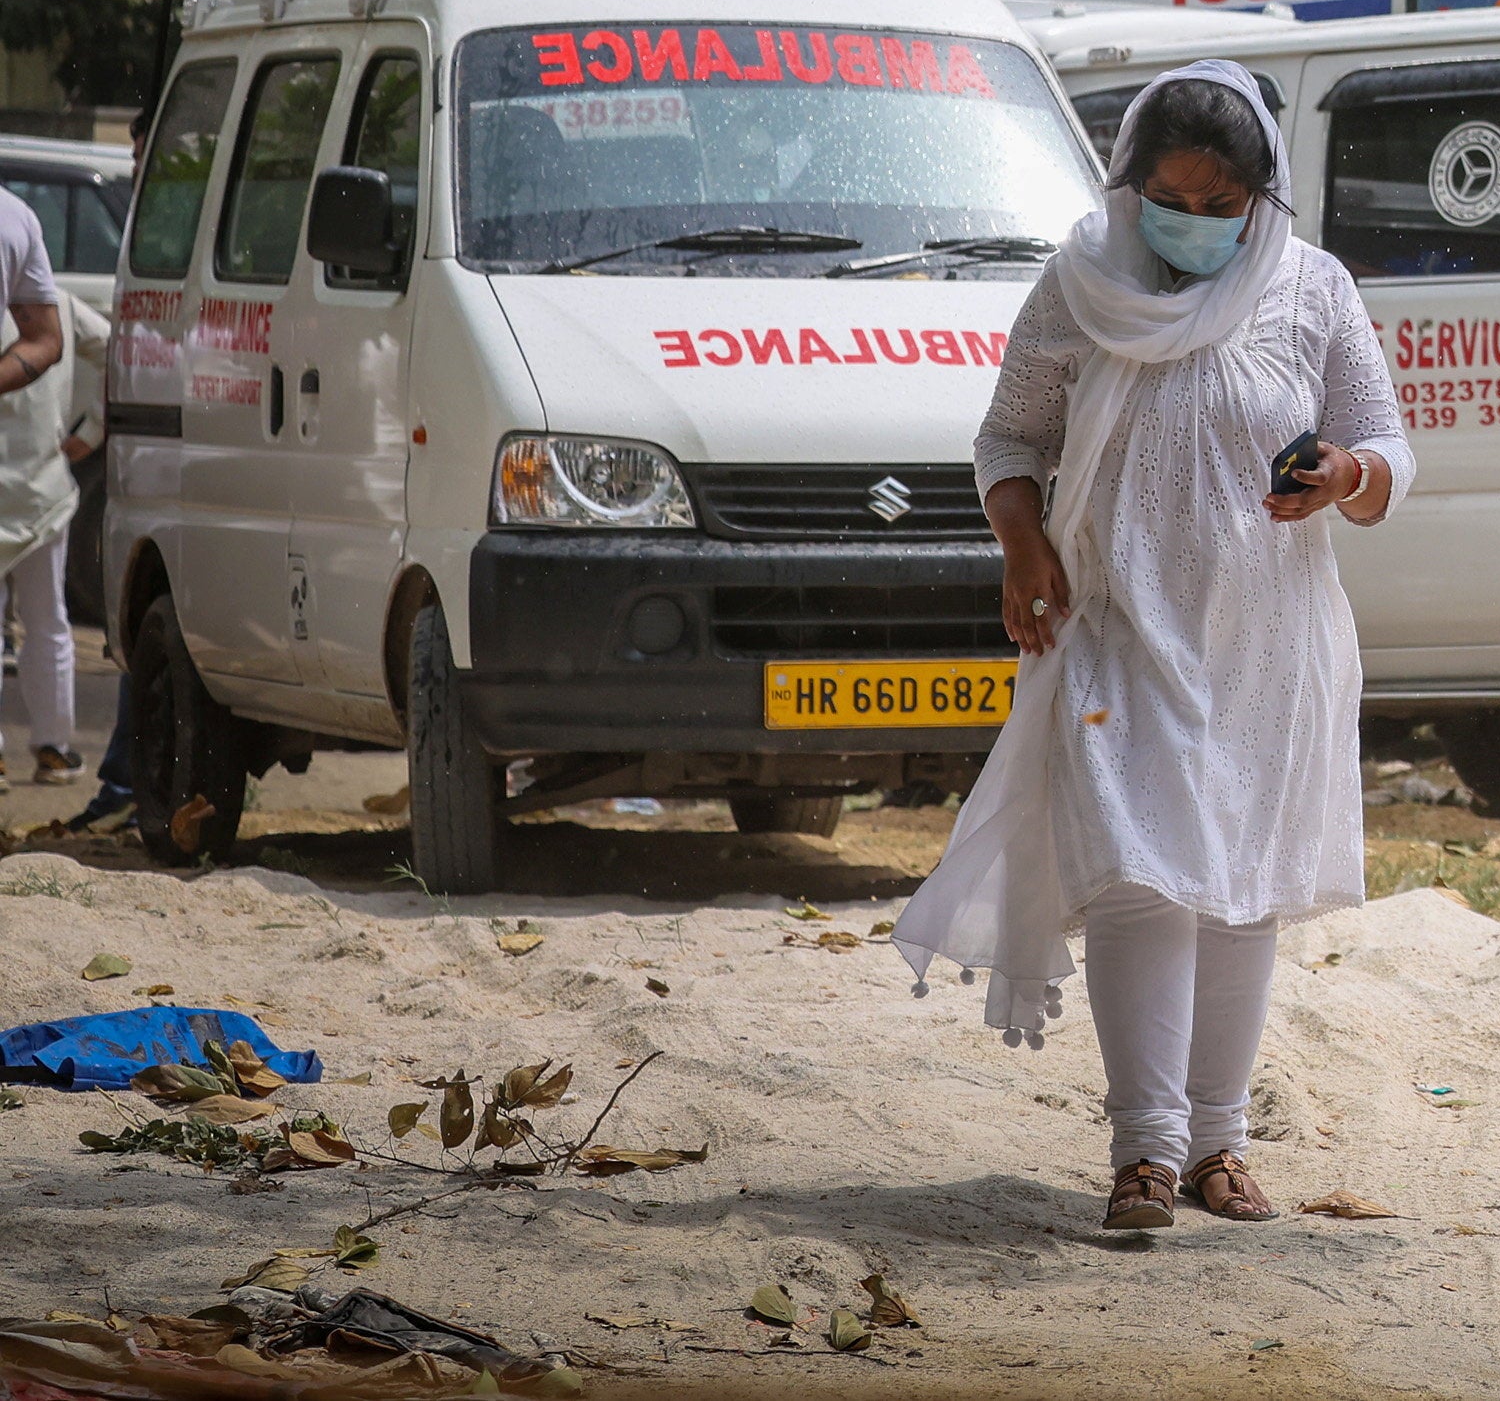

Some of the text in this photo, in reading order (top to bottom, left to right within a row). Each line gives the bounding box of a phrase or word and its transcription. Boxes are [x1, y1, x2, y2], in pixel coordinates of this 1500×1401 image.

[198, 297, 273, 355] AMBULANCE
[796, 677, 838, 715] HR
[852, 677, 918, 714] 66D
